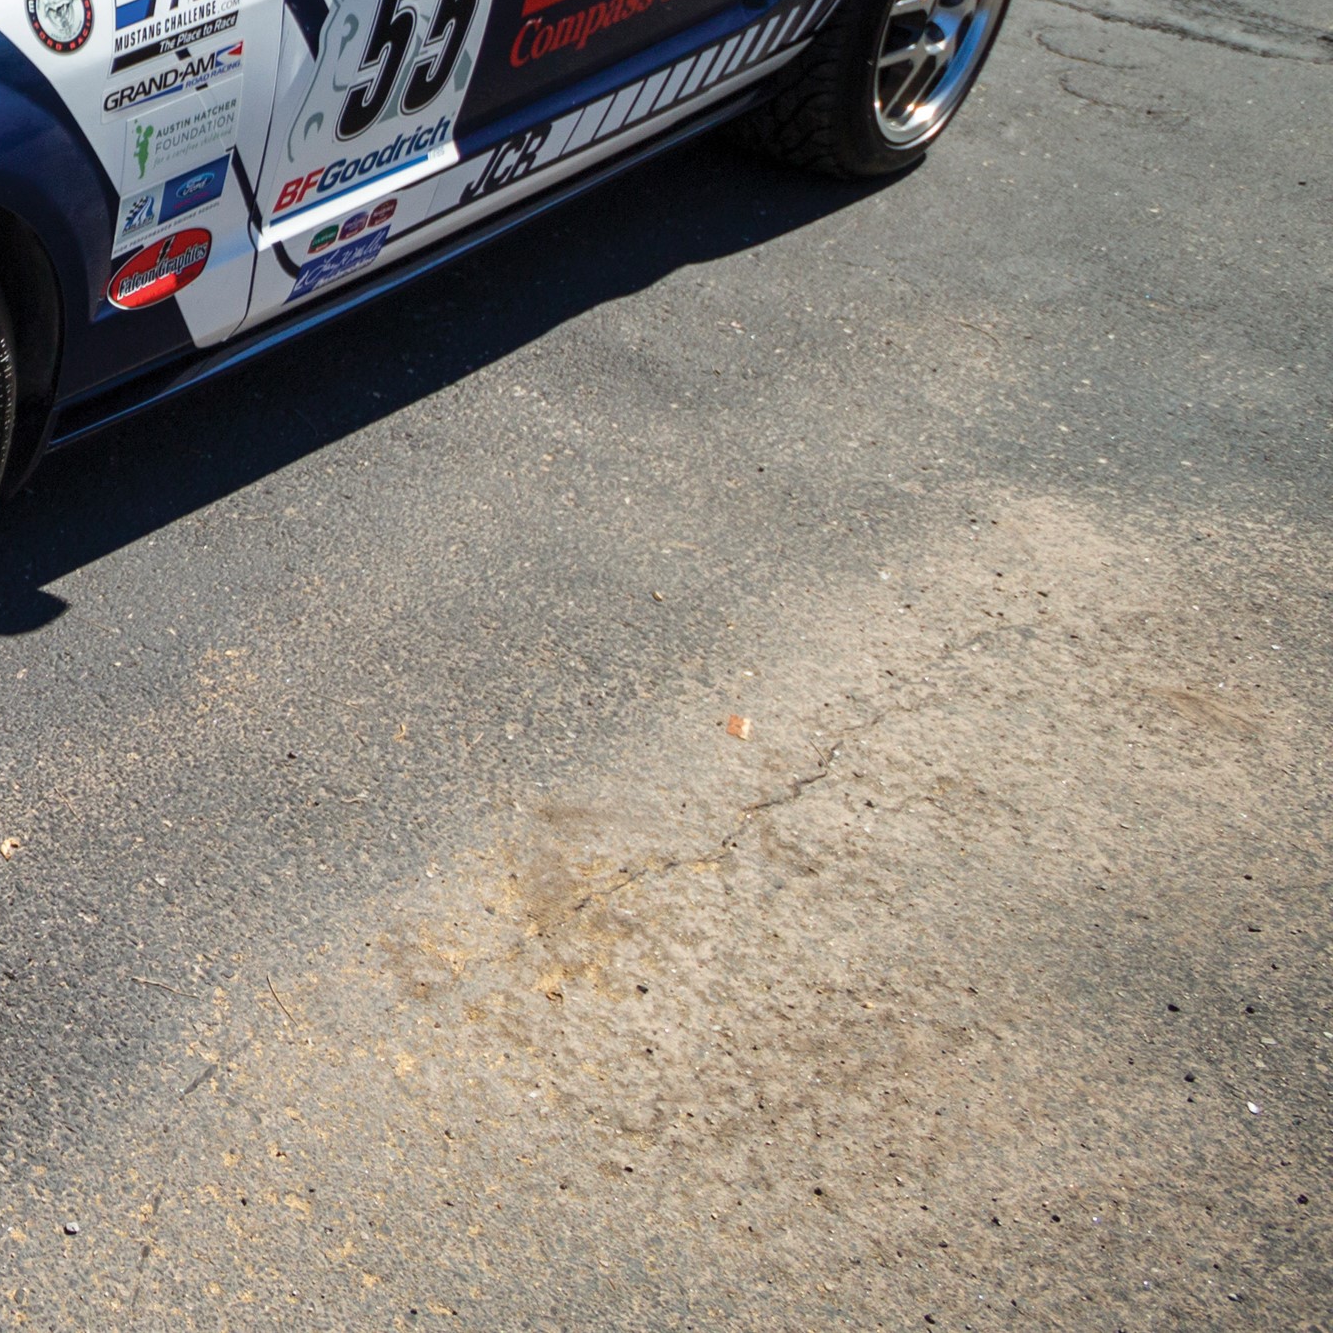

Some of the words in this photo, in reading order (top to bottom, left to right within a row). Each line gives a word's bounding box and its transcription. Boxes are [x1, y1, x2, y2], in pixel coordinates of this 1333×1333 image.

[114, 22, 162, 53] MUSTANG
[159, 37, 176, 54] The
[176, 28, 202, 46] Place
[202, 22, 214, 37] to
[213, 14, 236, 32] Race
[185, 73, 210, 89] ROAD
[210, 60, 242, 79] RACING
[154, 112, 236, 154] FOUNDATION
[156, 117, 191, 139] AUSTIN
[193, 98, 237, 123] HATCHER
[273, 116, 452, 213] BFGoodrich
[459, 122, 553, 204] JCR
[182, 176, 209, 196] Ford
[117, 268, 157, 300] Falcon
[157, 241, 208, 279] Graphics
